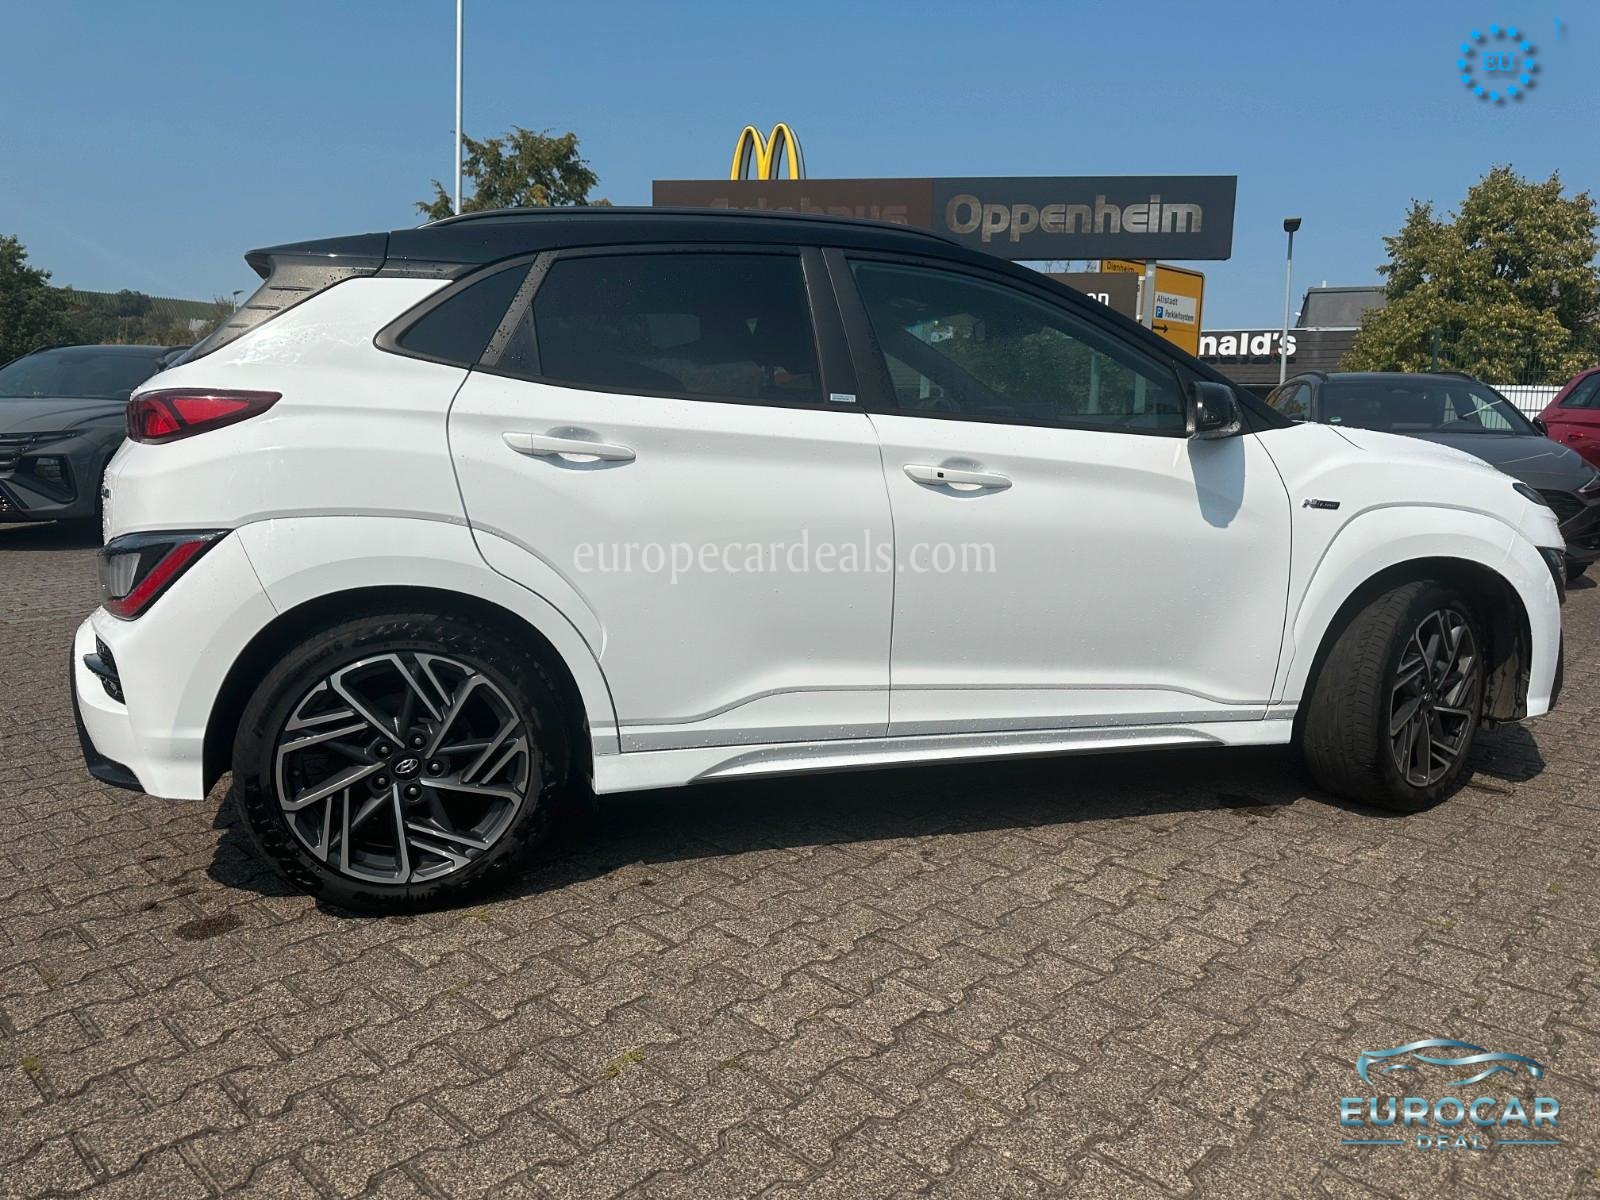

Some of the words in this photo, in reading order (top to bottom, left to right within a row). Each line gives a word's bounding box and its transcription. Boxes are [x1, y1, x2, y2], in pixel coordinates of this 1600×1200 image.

[945, 194, 1203, 242] Oppenheim
[1157, 295, 1178, 305] Altstadt
[1199, 332, 1297, 356] nald's
